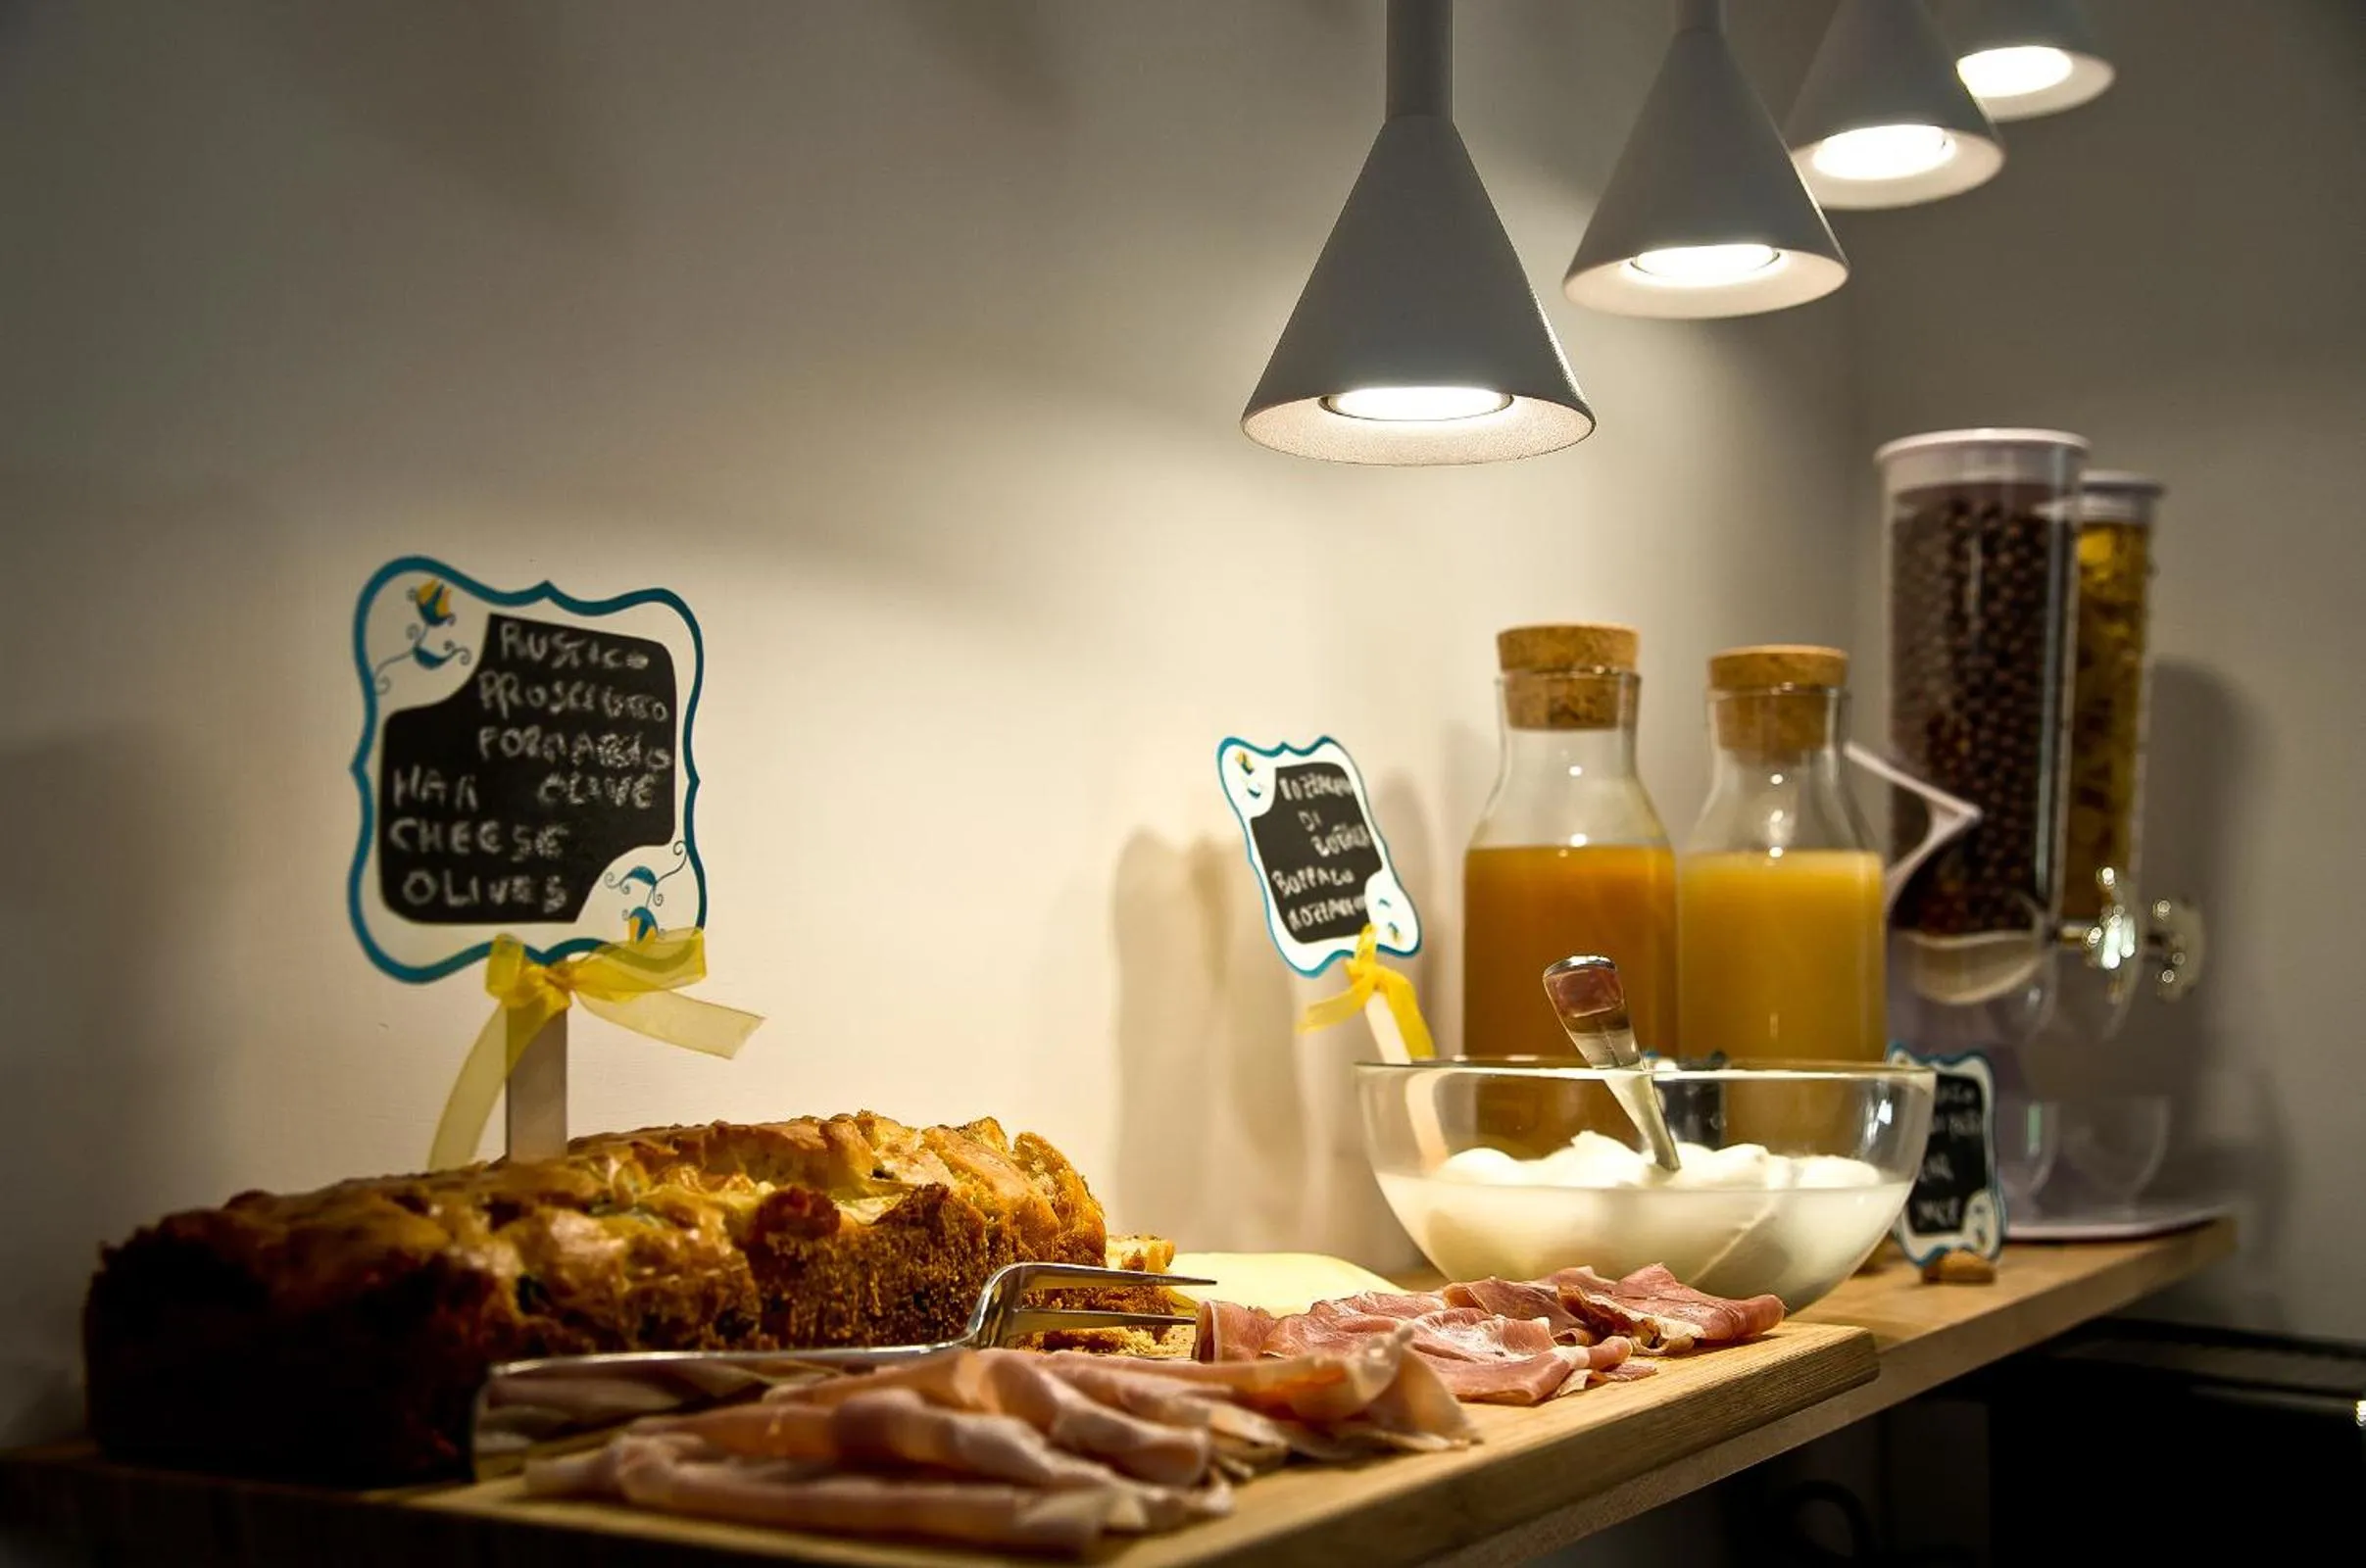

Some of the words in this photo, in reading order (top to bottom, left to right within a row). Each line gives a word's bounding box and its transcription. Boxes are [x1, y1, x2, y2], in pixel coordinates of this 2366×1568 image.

[537, 773, 657, 810] OLIVE
[390, 816, 569, 861] CHEESE
[402, 870, 568, 913] OLIVES
